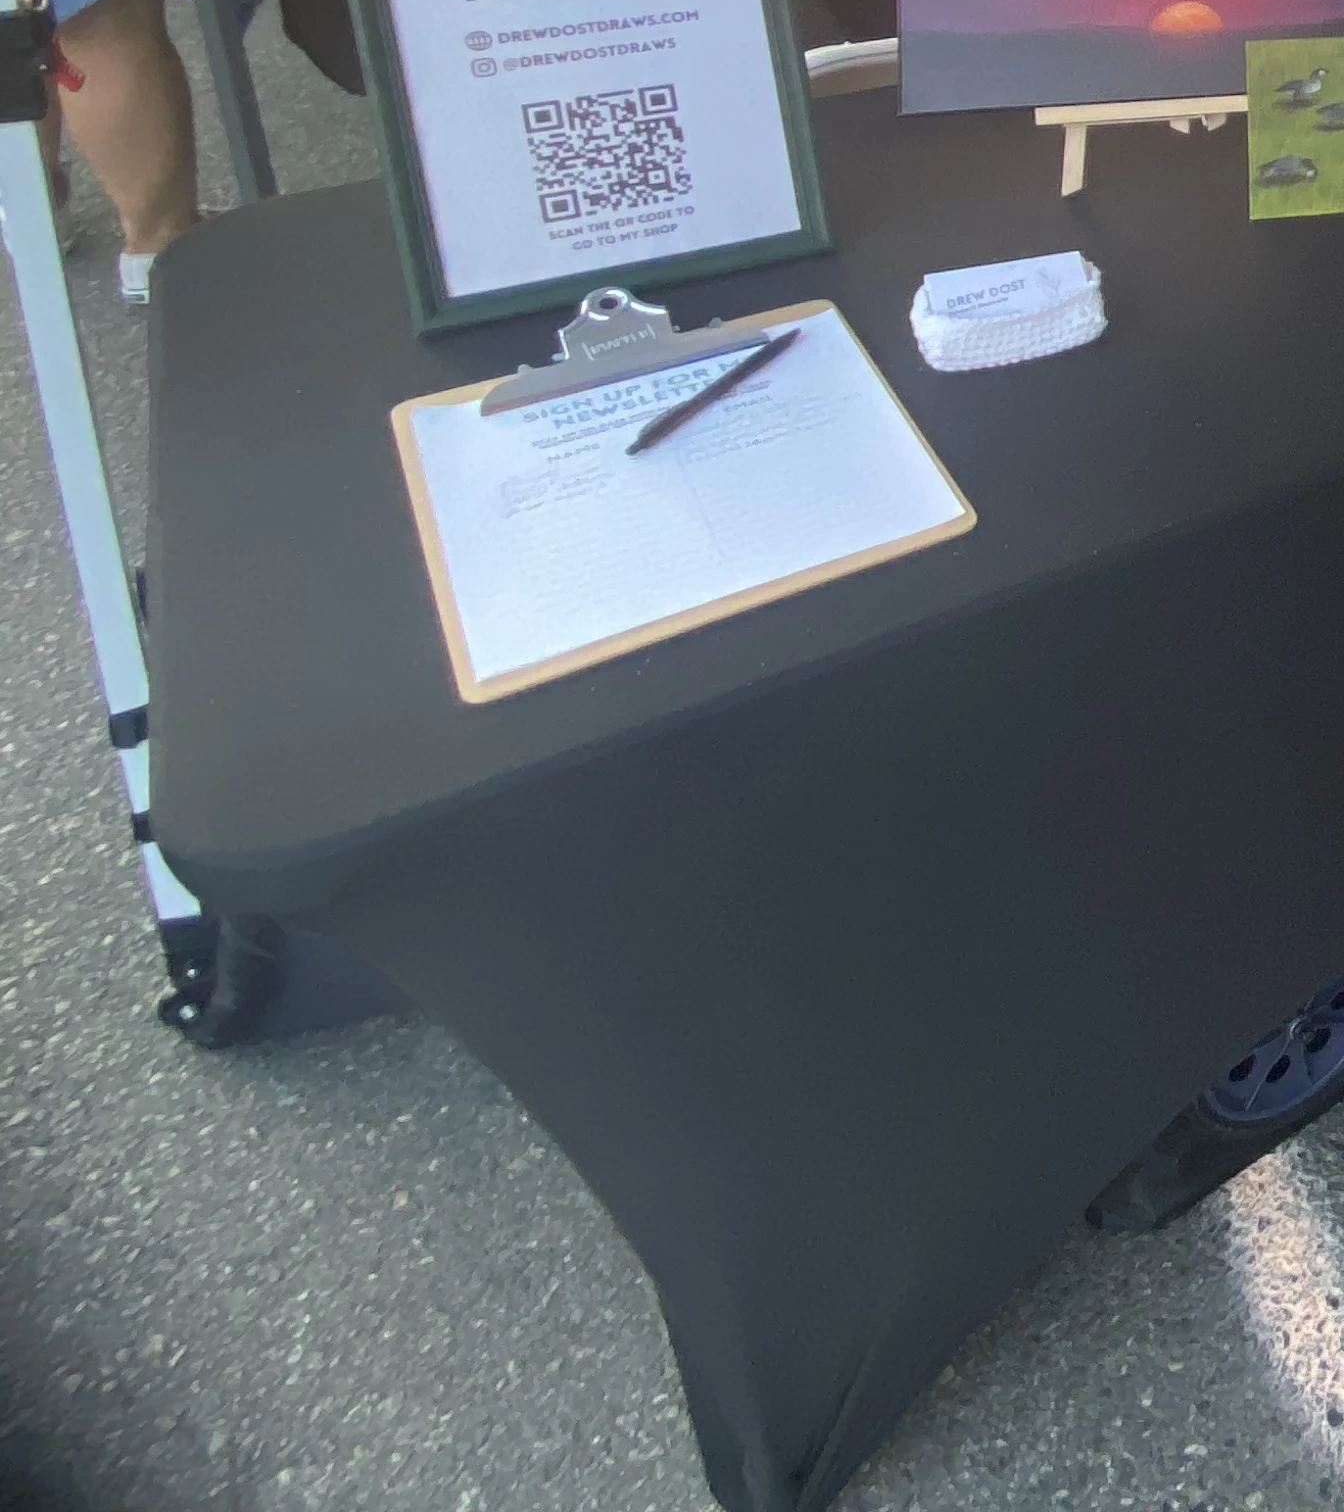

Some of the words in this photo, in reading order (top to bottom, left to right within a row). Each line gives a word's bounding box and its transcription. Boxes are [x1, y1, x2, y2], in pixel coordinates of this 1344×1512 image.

[497, 9, 700, 45] DREWDOSTDRAWS.COM
[502, 37, 677, 71] @DREWDOSTDRAWS
[549, 225, 584, 240] SCAN
[586, 222, 611, 233] THE
[615, 217, 635, 228] QR
[637, 210, 673, 224] CODE
[677, 205, 696, 216] TO
[571, 239, 594, 251] GO
[597, 235, 617, 246] TO
[620, 229, 641, 242] MY
[643, 223, 679, 238] SHOP
[946, 289, 986, 310] DREW
[988, 278, 1026, 299] DOST
[521, 396, 595, 424] SIGN
[602, 384, 642, 402] UP
[651, 368, 711, 389] FOR
[552, 378, 715, 430] NEWSLETT
